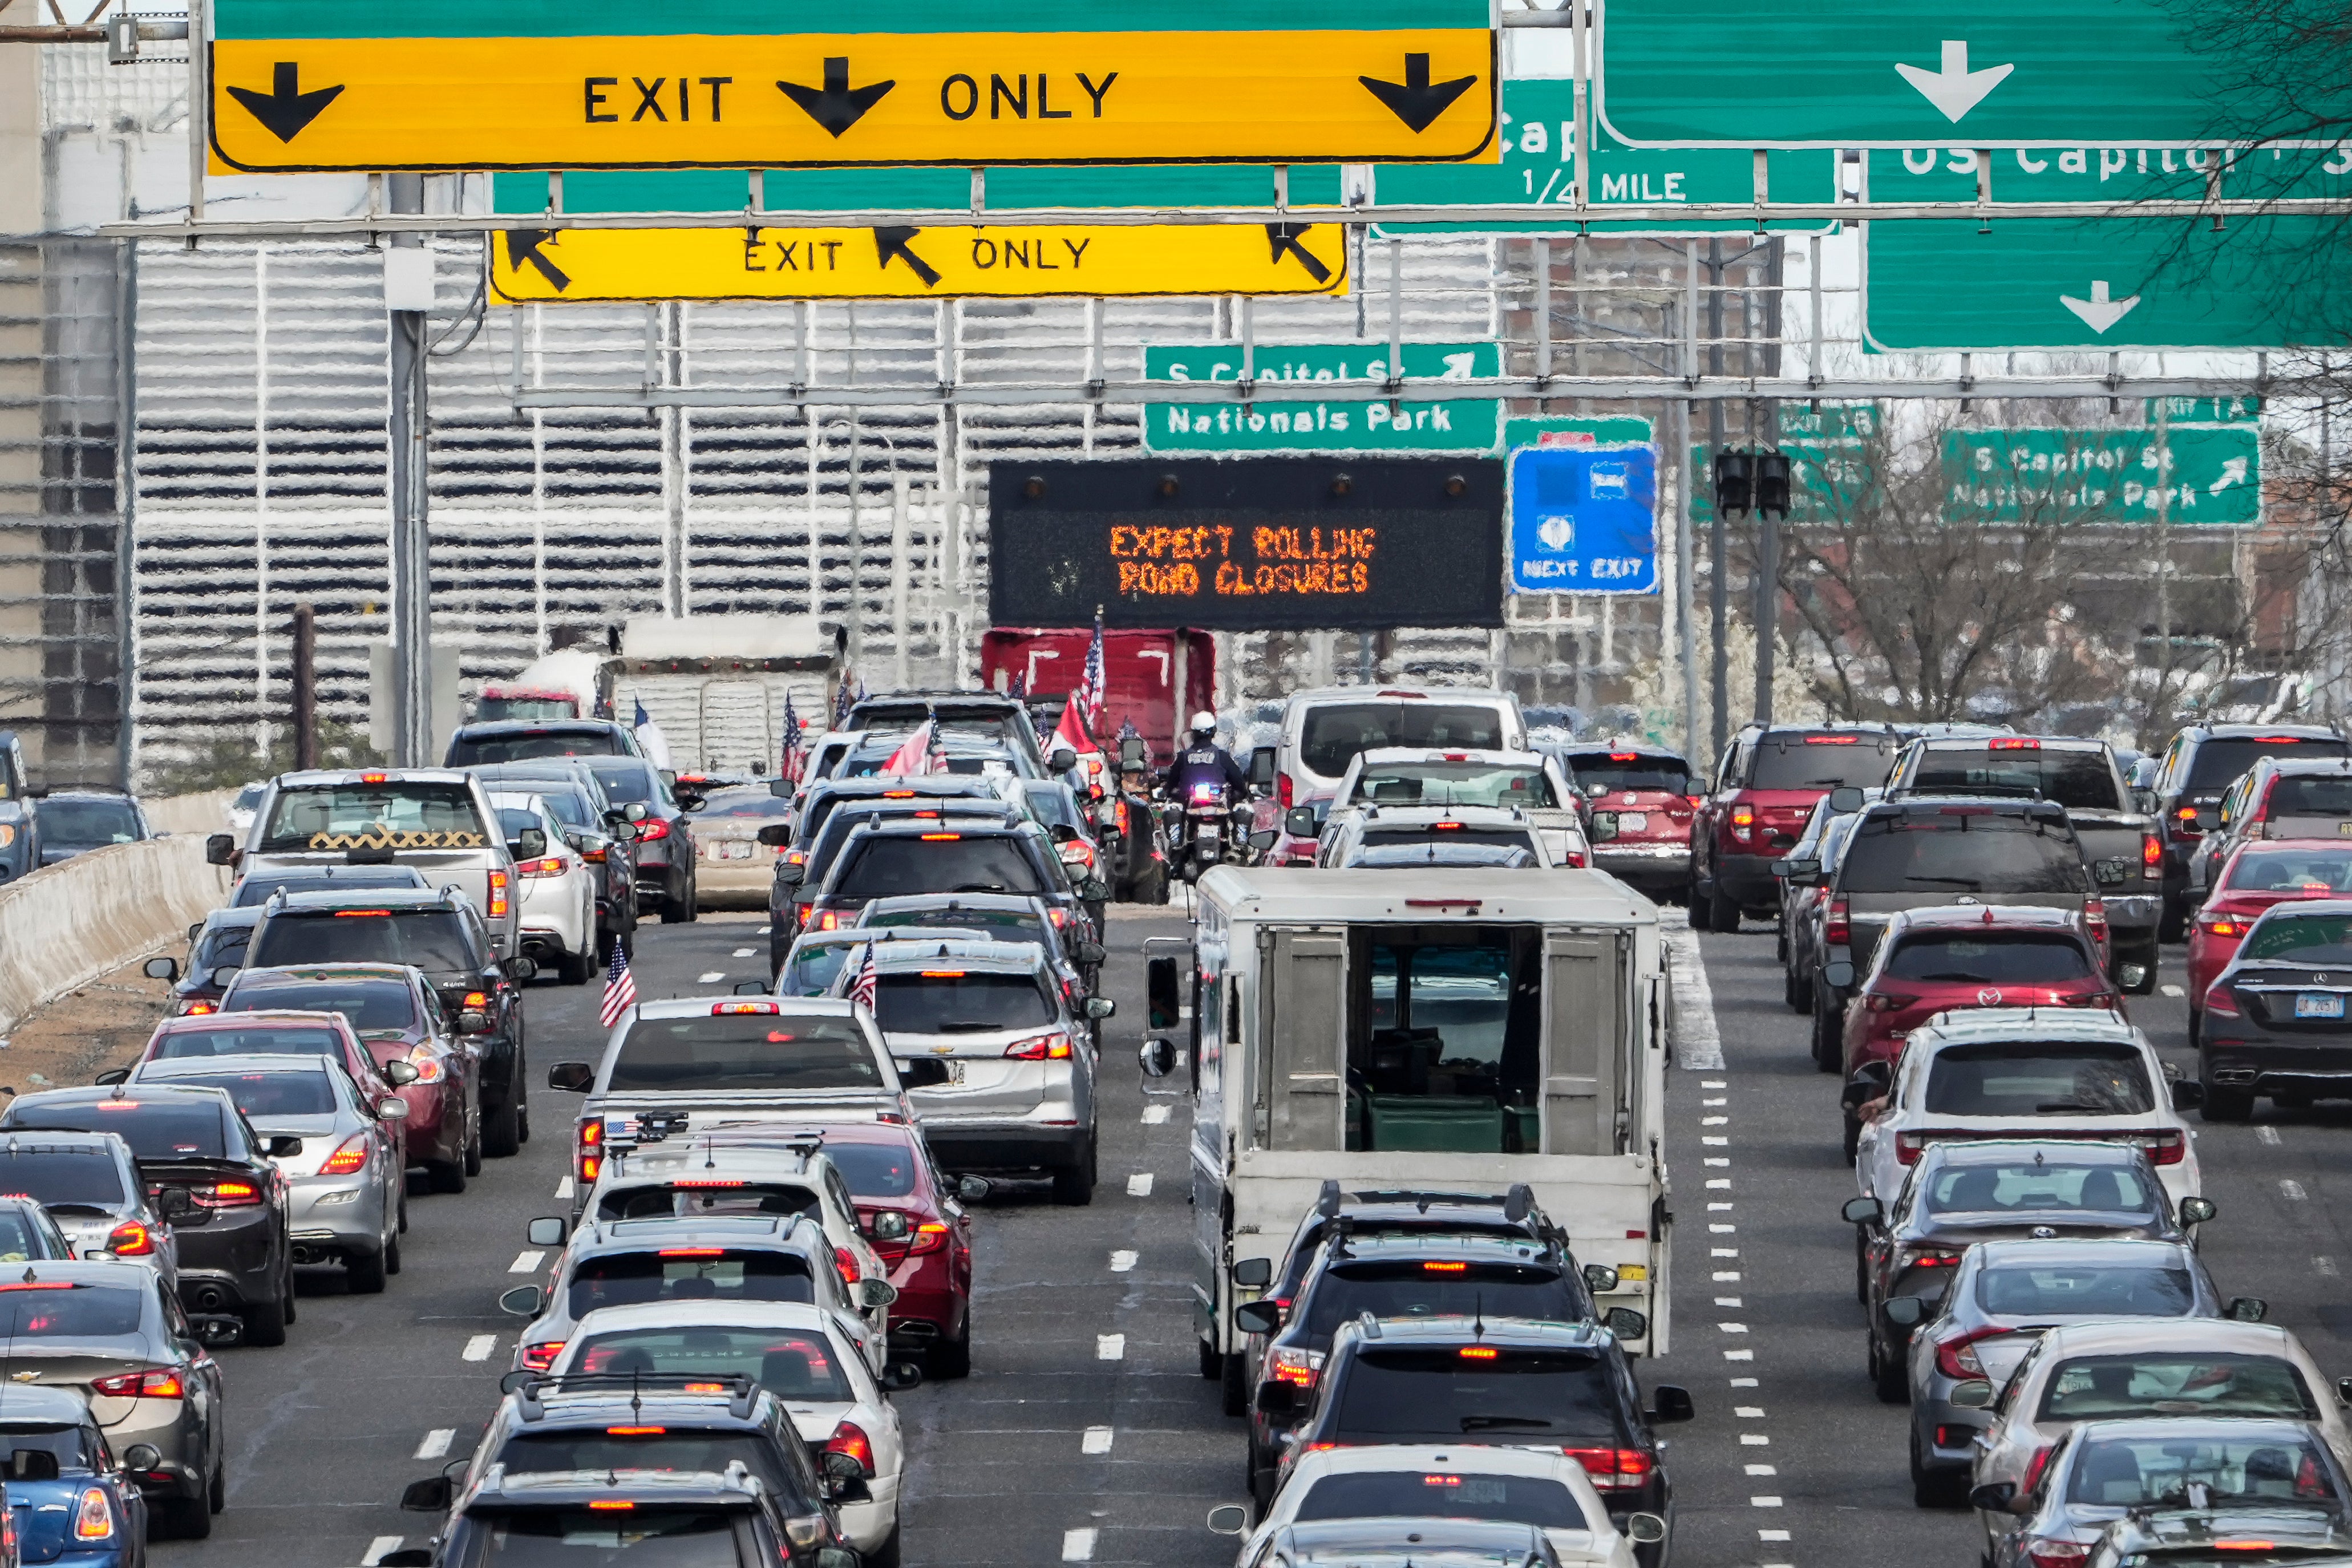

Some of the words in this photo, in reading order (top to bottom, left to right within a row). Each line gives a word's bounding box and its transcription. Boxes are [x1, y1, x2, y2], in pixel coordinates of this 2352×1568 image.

[585, 76, 732, 123] EXIT
[940, 72, 1119, 121] ONLY
[1601, 172, 1687, 201] MILE
[744, 240, 843, 272] EXIT
[971, 237, 1091, 270] ONLY
[1366, 359, 1406, 380] S
[1168, 403, 1350, 434] Nationals
[1367, 403, 1452, 432] Park
[1974, 447, 1993, 472] S
[2011, 444, 2125, 477] Capitol
[2123, 480, 2197, 510] Park
[1110, 524, 1234, 560] EXPECT
[1253, 525, 1376, 560] ROLLING
[1117, 560, 1200, 596] ROAD
[1215, 560, 1369, 595] CLOSURES
[1522, 558, 1580, 579] NEXT
[1590, 556, 1643, 580] EXIT
